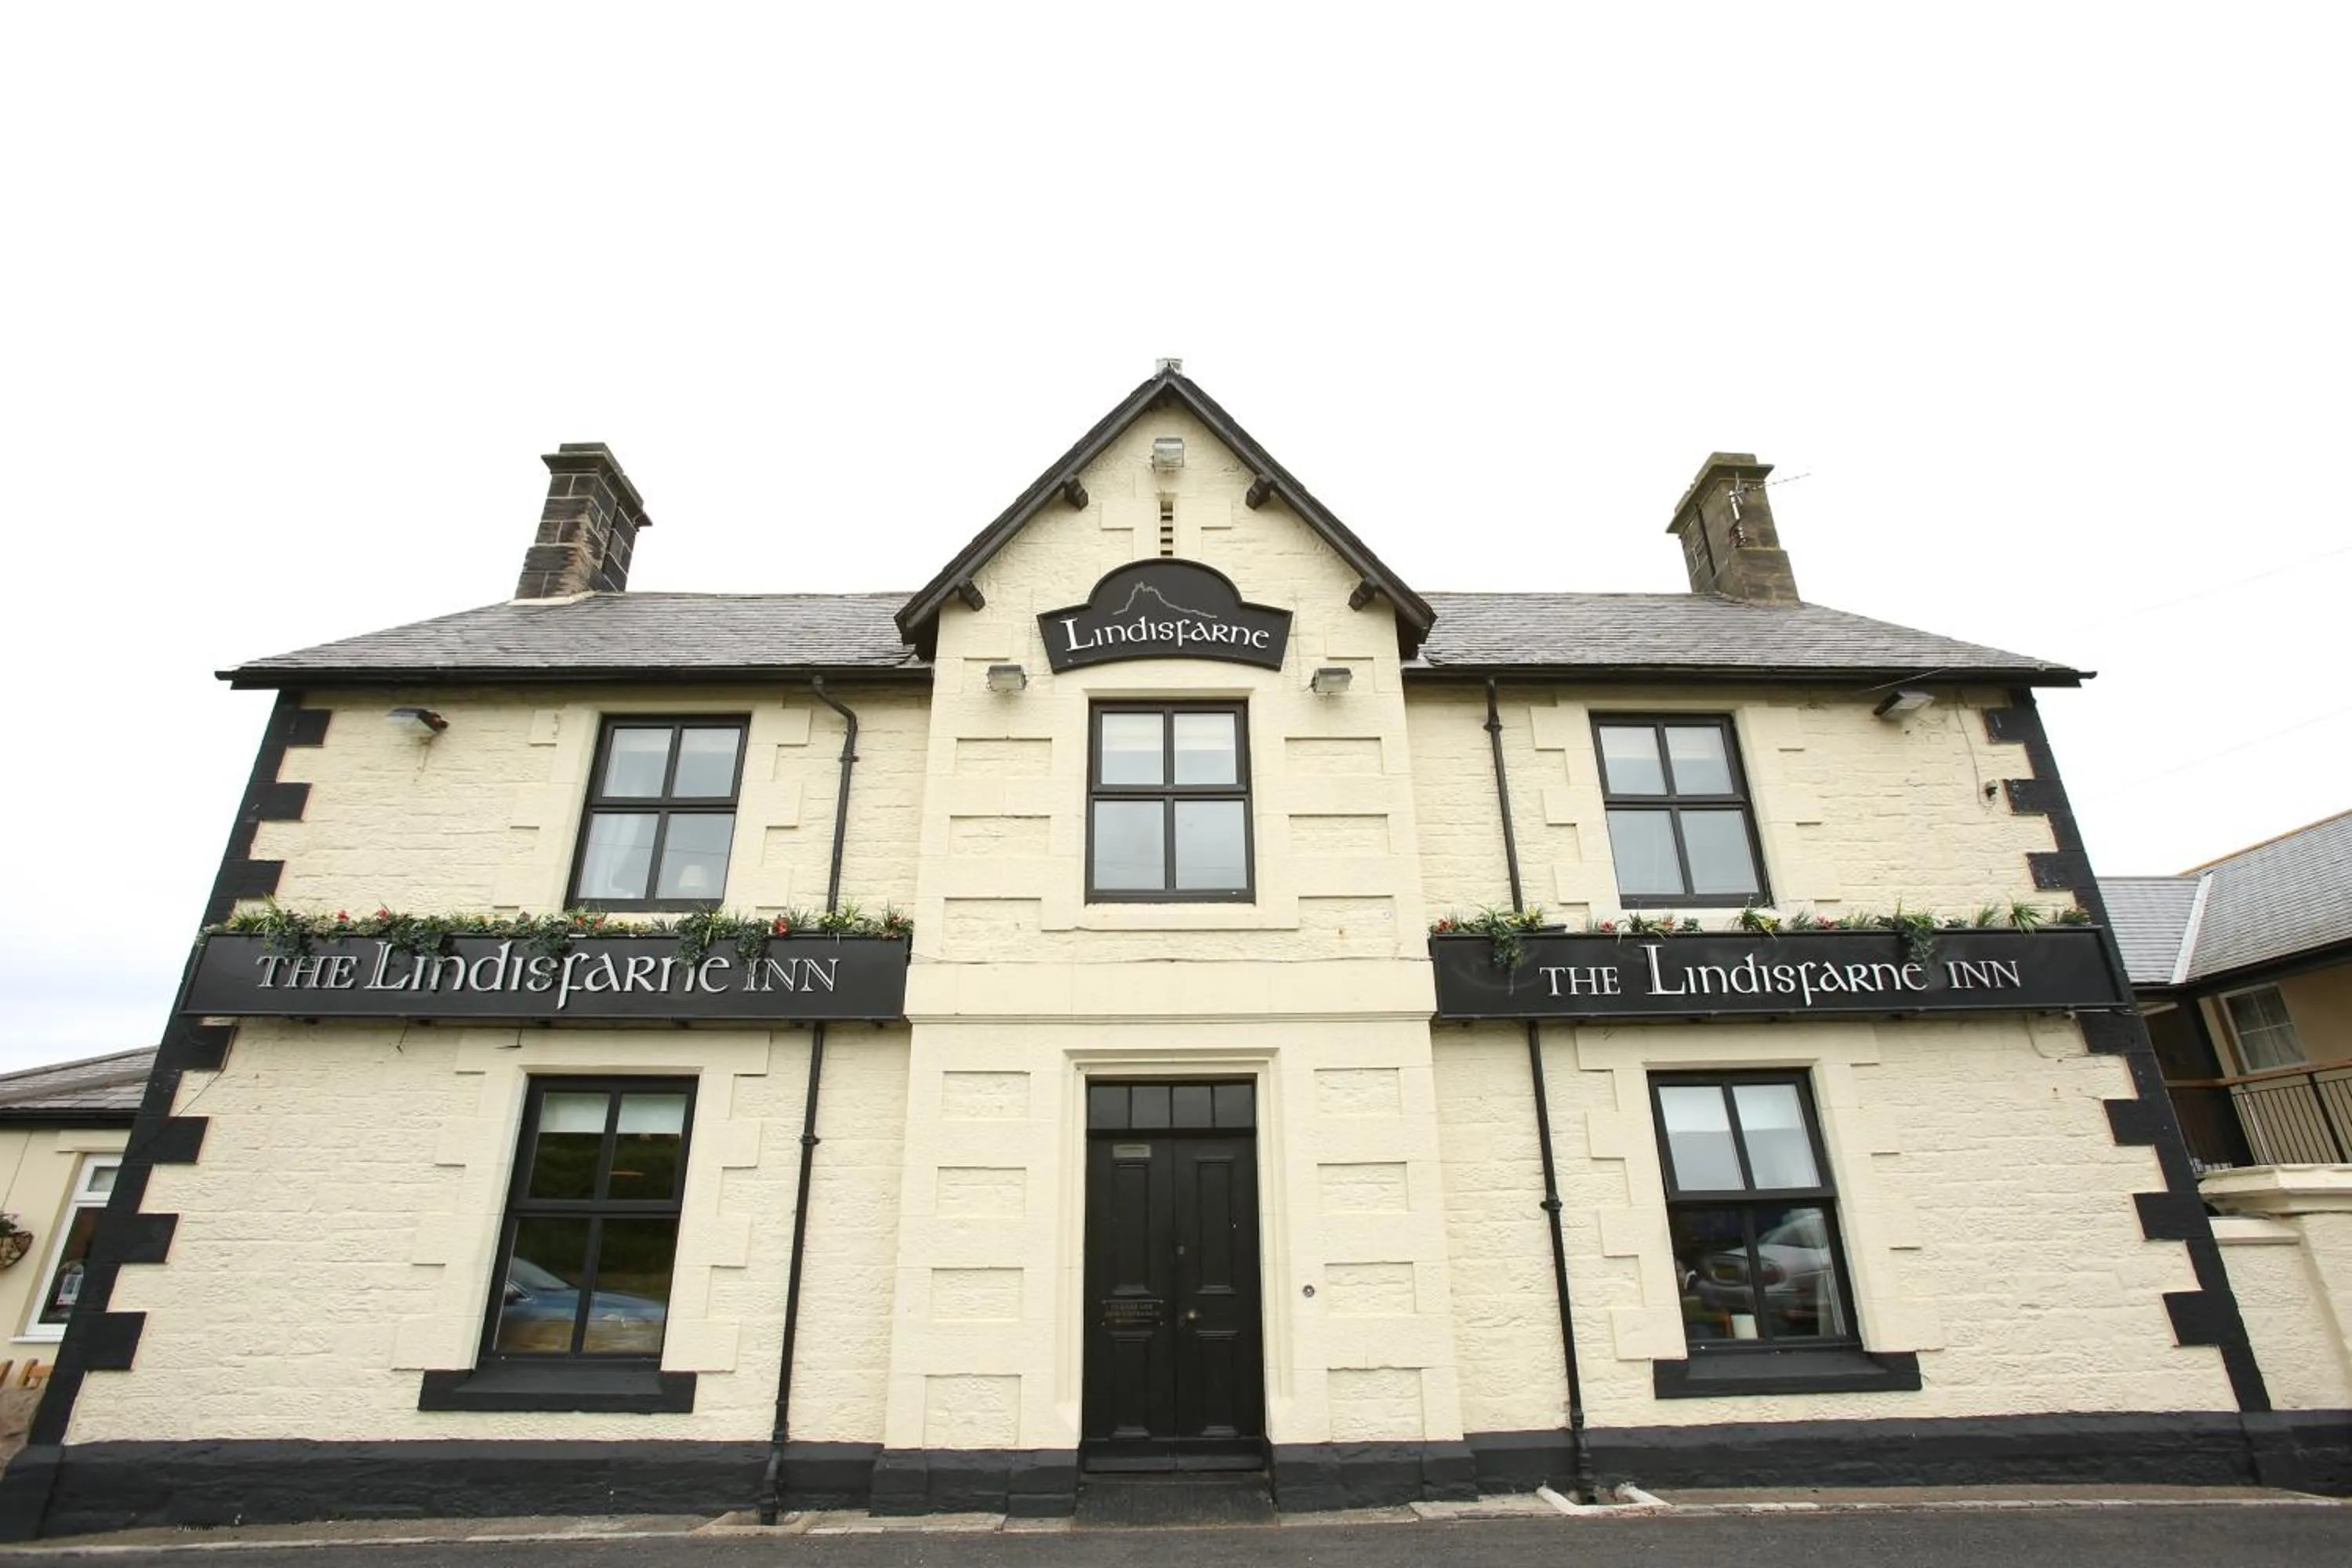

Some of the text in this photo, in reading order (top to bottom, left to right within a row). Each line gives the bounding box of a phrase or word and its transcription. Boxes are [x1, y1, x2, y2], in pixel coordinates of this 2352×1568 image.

[1059, 615, 1270, 652] Lindisfarne
[256, 955, 358, 989] THE
[743, 957, 840, 993] INN
[1539, 967, 1621, 996] THE
[1946, 960, 2021, 989] INN
